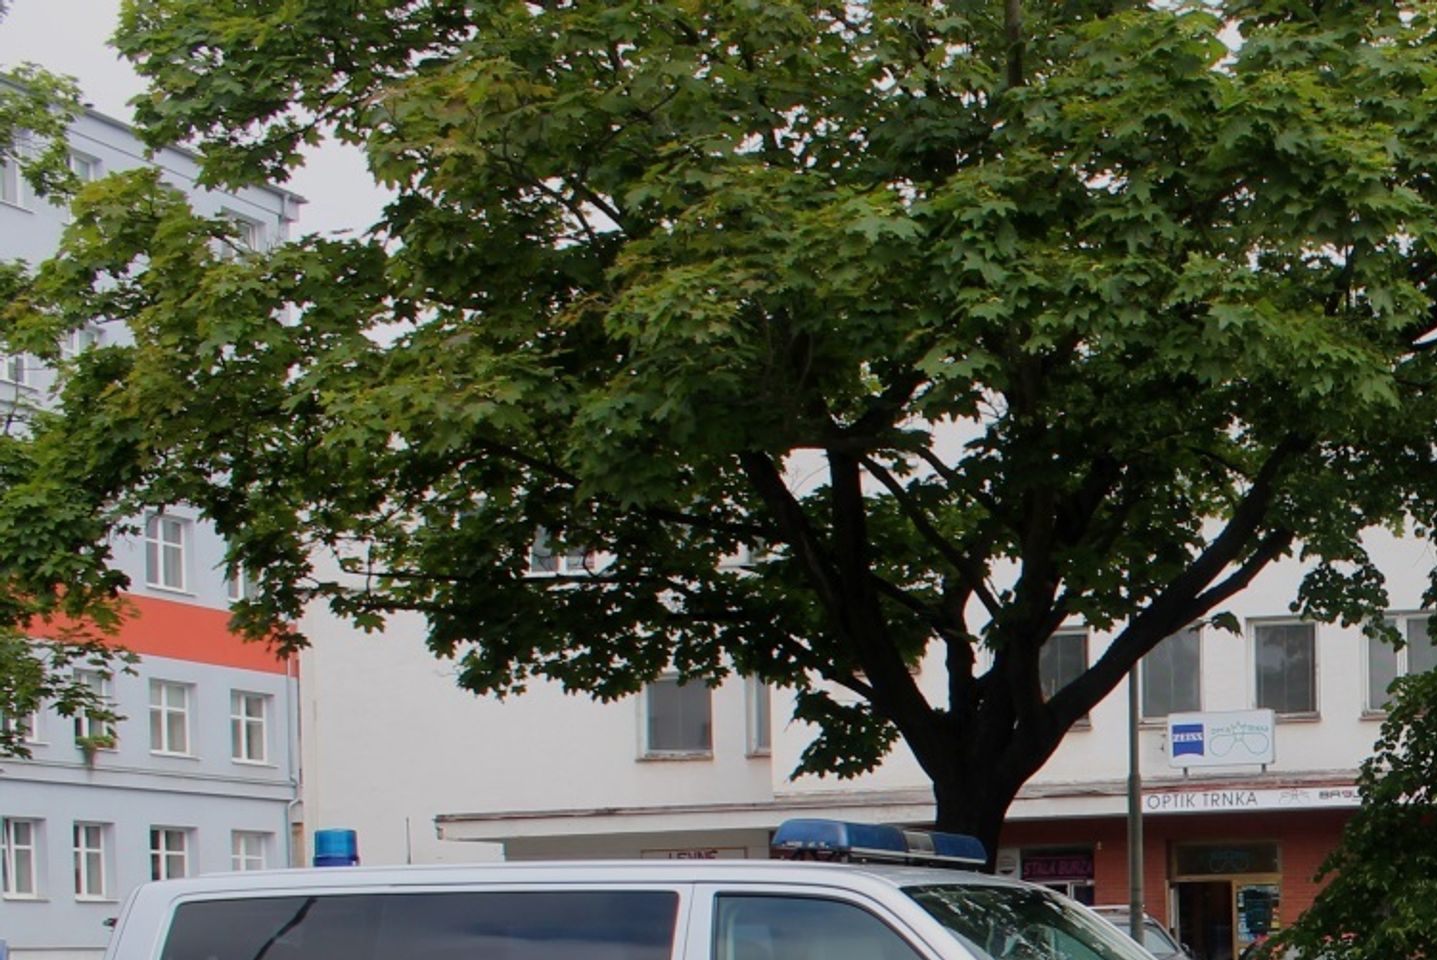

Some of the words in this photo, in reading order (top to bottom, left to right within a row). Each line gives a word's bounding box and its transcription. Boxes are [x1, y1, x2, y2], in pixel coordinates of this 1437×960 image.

[1172, 731, 1203, 742] ZEISS
[1147, 793, 1196, 810] OPTIK
[1201, 791, 1258, 807] TRNKA
